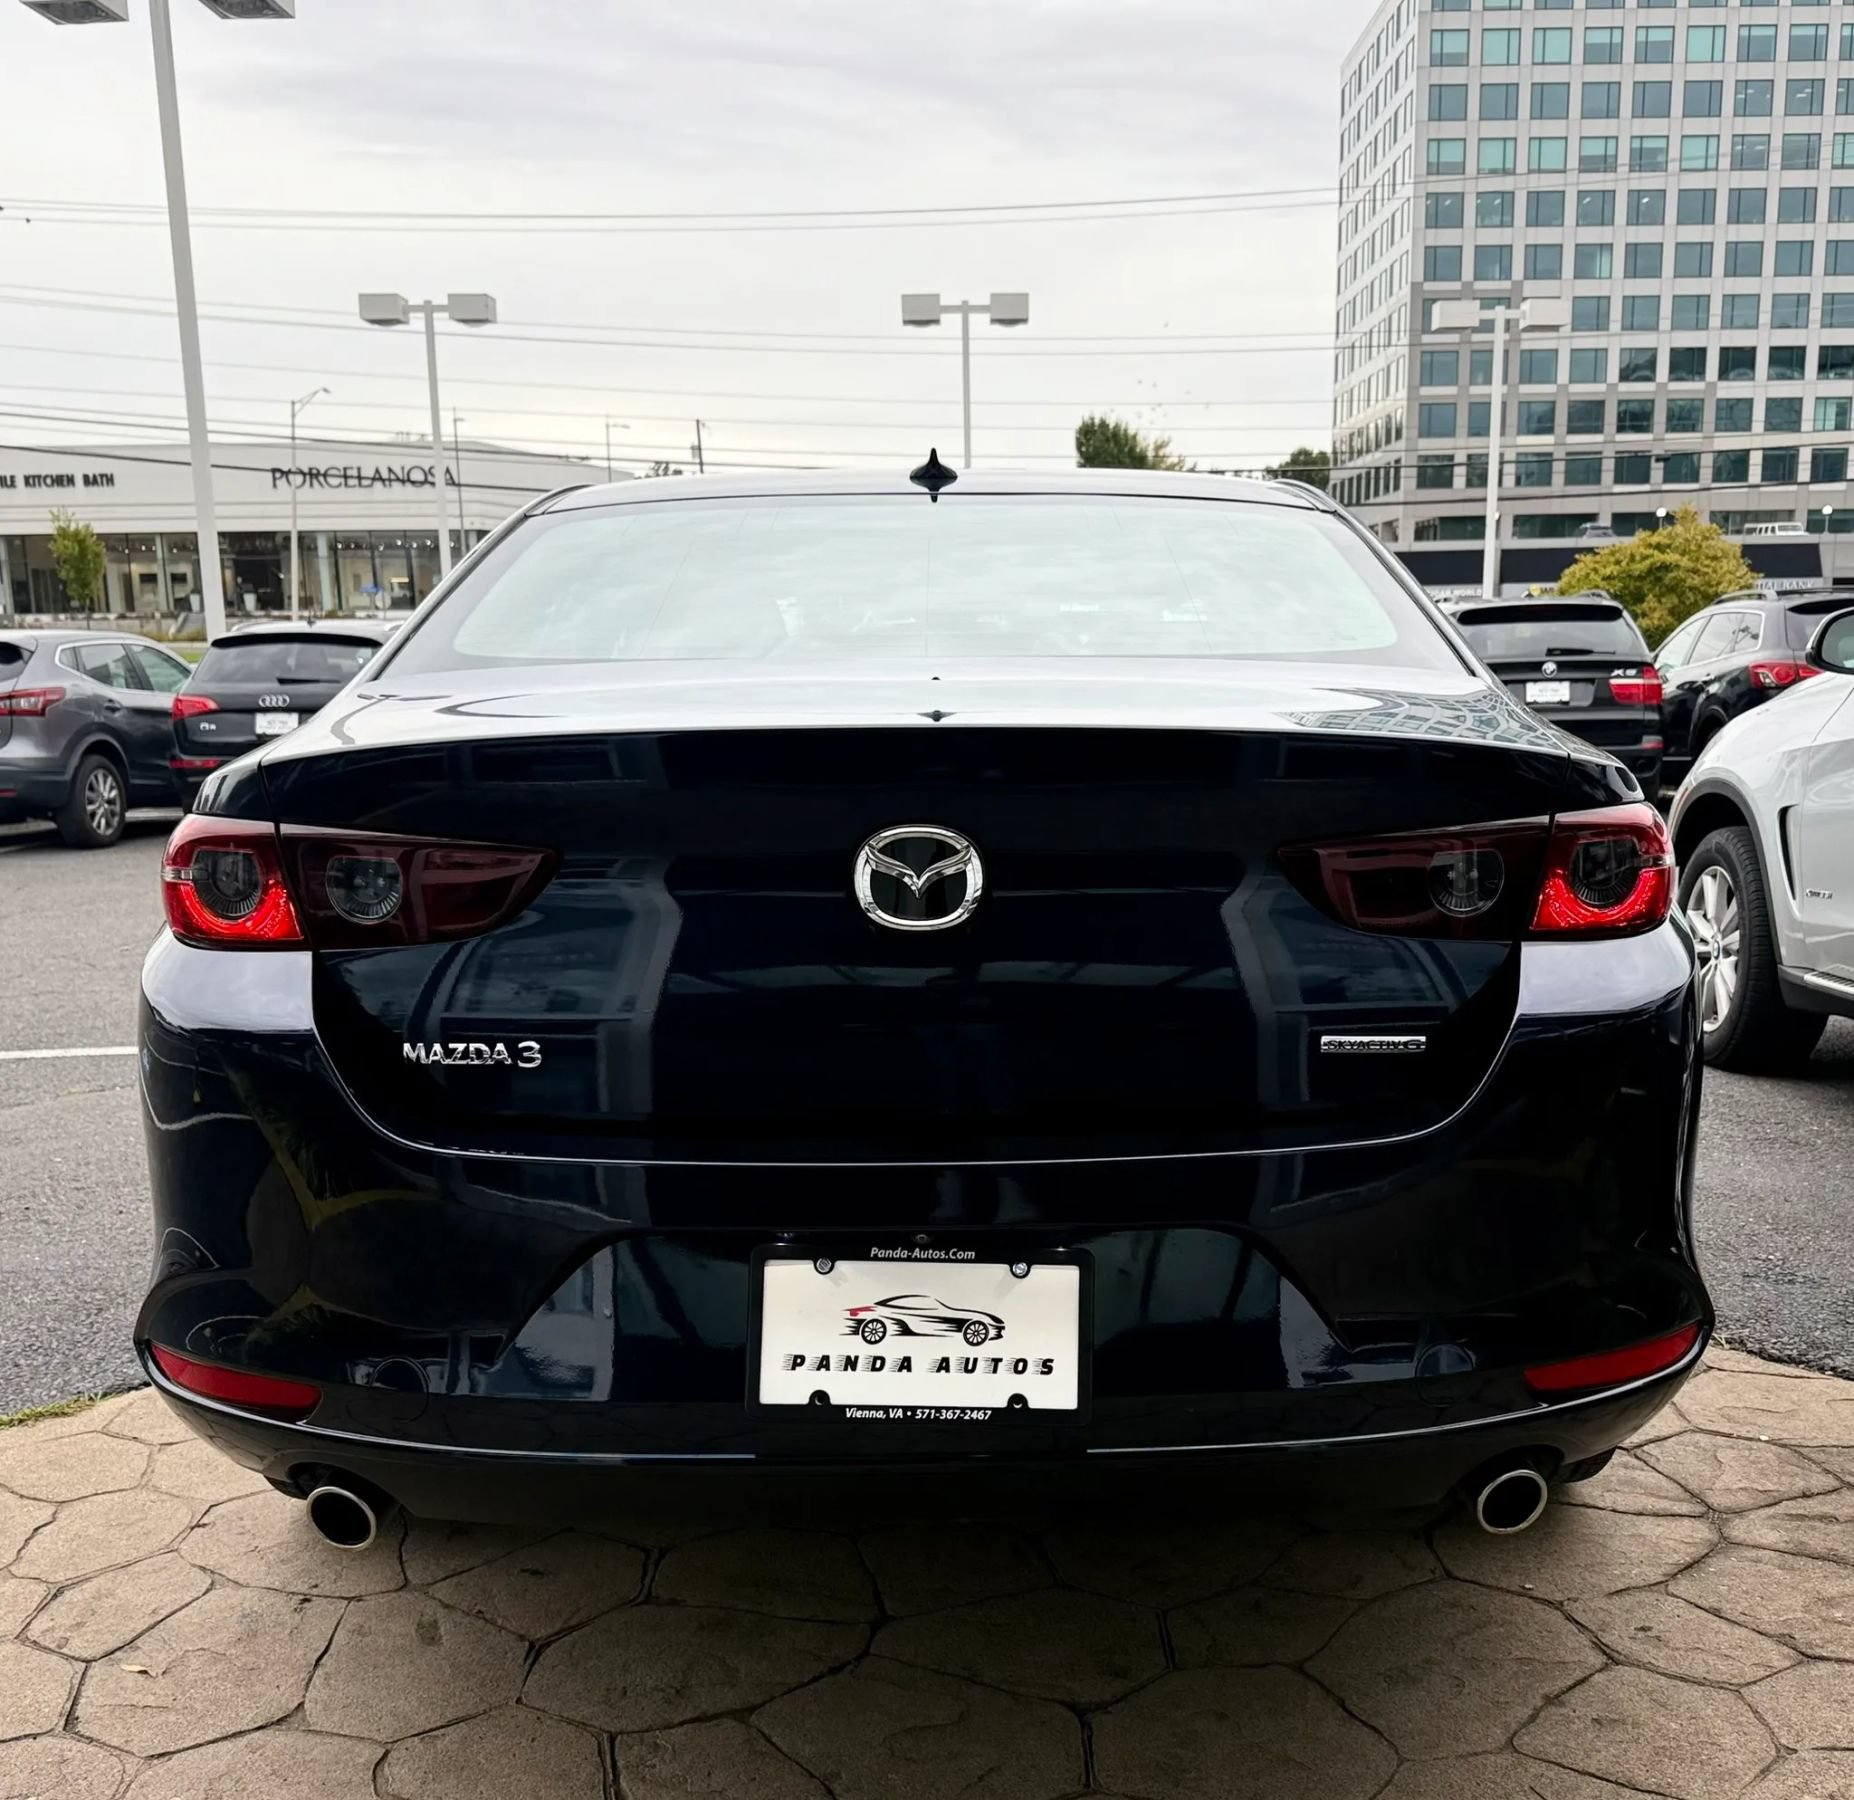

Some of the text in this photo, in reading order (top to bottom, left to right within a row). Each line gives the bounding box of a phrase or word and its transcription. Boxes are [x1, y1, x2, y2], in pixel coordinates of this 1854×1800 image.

[24, 474, 75, 488] KITCHEN
[82, 473, 115, 487] BATH
[403, 1041, 542, 1068] MAZDA 3
[870, 1247, 975, 1260] Panda-Autos.Com
[783, 1353, 1055, 1376] PANDA AUTOS
[845, 1407, 992, 1420] Vienna, VA 571-367-2467
